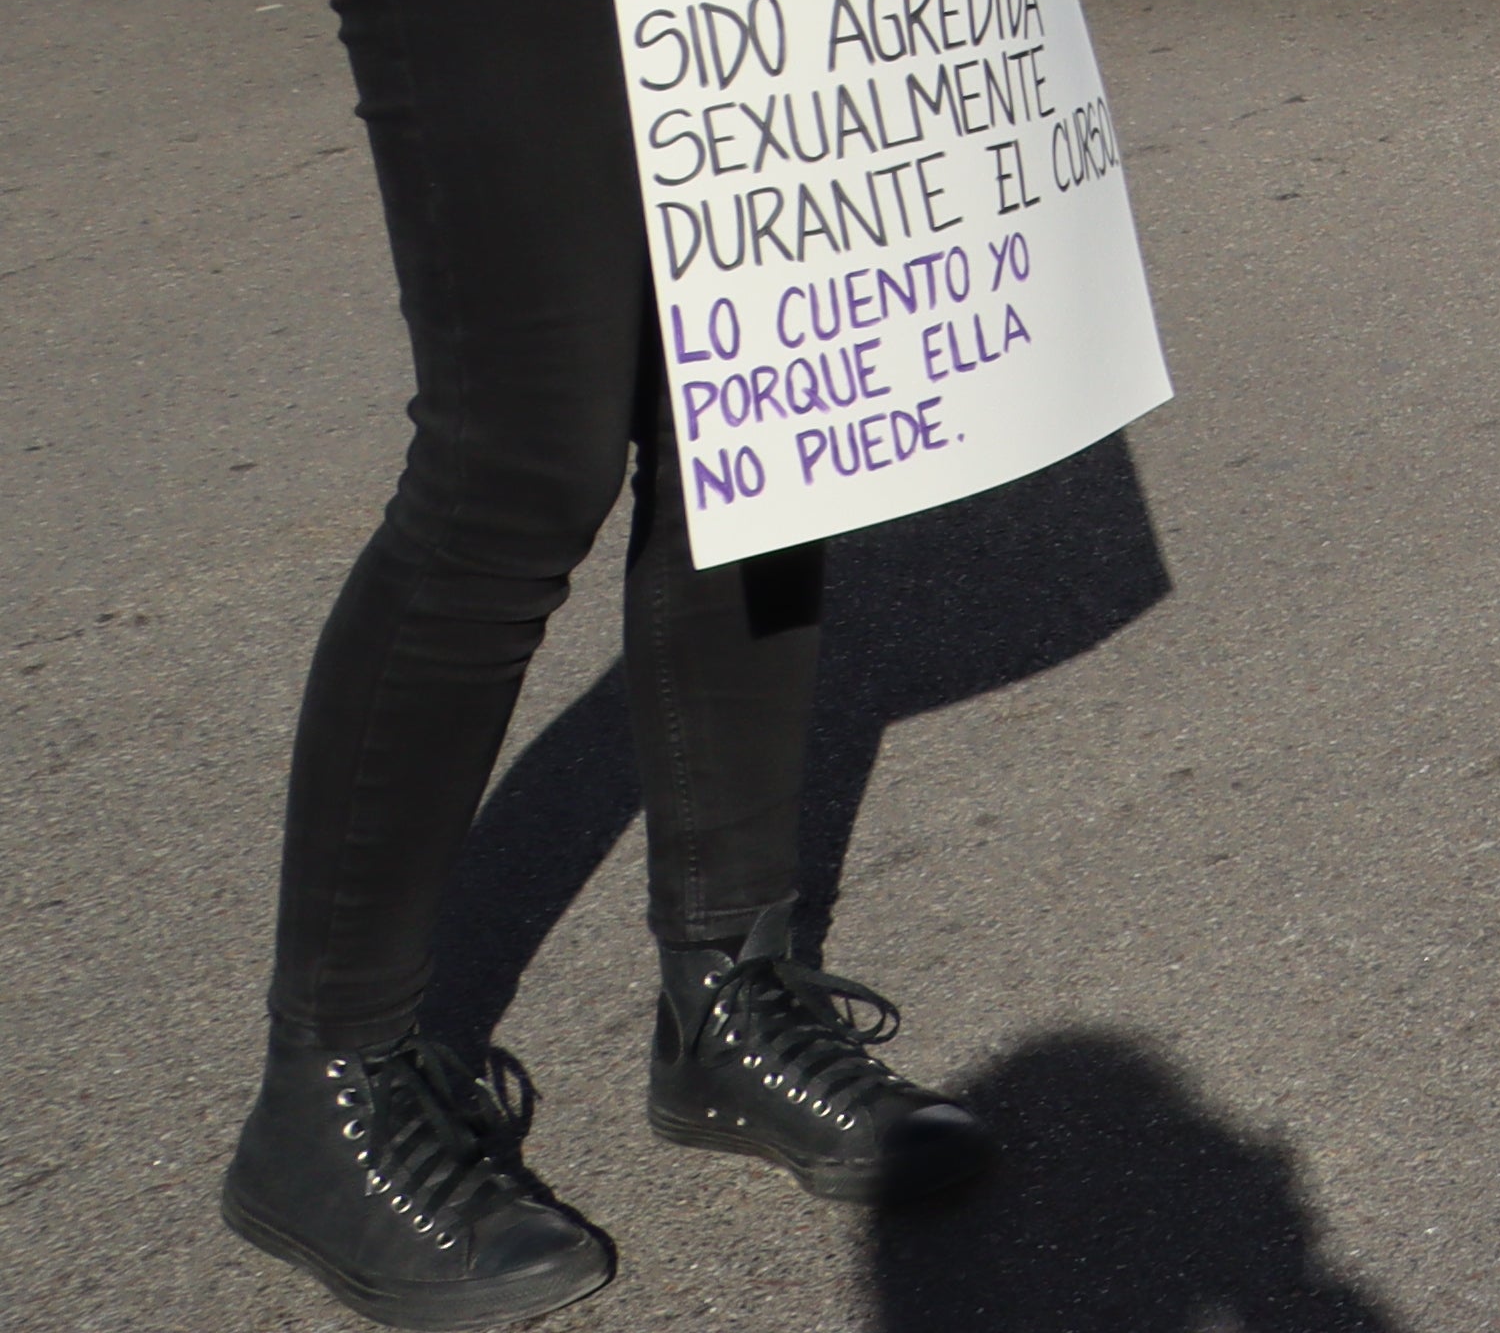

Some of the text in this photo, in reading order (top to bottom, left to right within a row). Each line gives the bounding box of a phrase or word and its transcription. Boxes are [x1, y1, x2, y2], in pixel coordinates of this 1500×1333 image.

[646, 43, 1058, 187] SEXUALMENTE
[655, 152, 963, 283] DURANTE
[992, 140, 1044, 217] EL
[668, 229, 1031, 367] LO CUENTO YO
[681, 302, 1034, 442] PORQUE ELLA
[690, 396, 970, 514] NO PUEDE.
